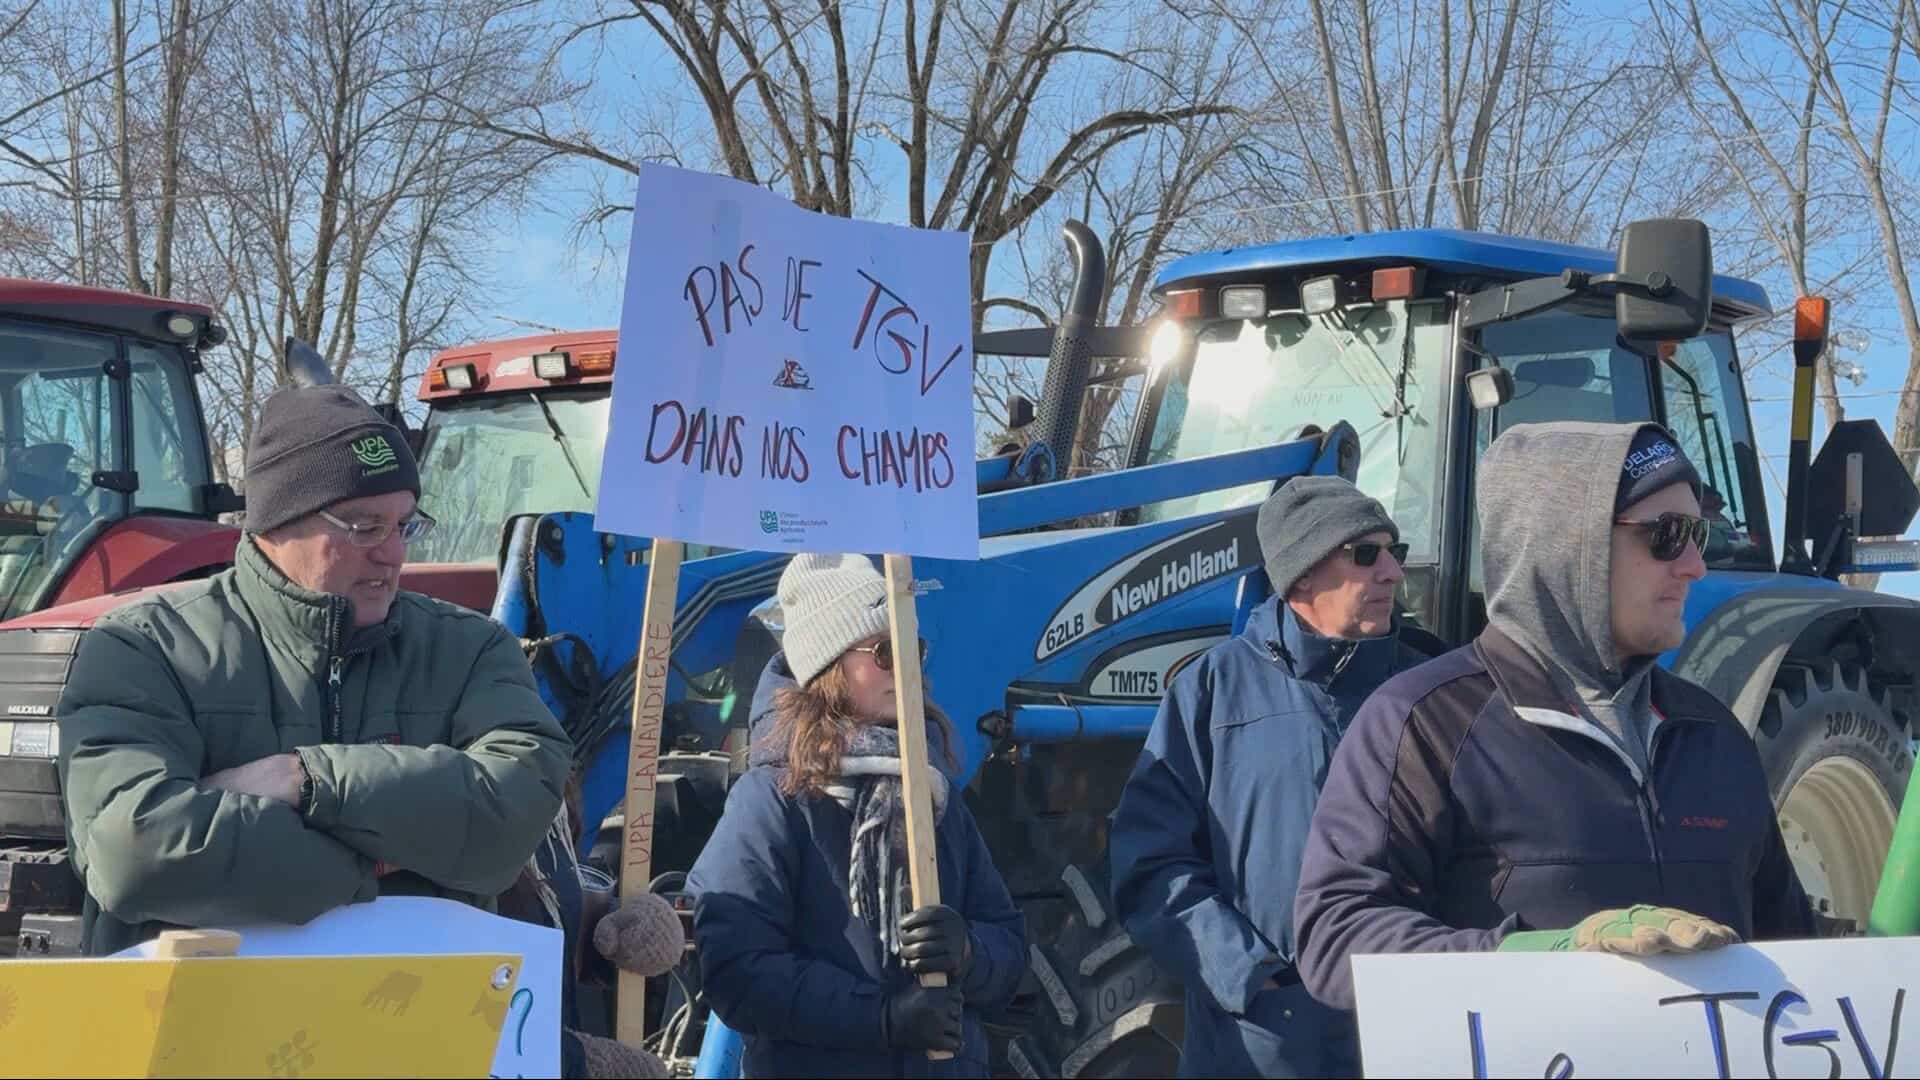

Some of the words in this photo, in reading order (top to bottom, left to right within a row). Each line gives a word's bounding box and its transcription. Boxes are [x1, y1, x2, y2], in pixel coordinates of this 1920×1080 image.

[684, 244, 764, 347] PAS
[782, 256, 823, 332] DE
[853, 268, 963, 396] TGV
[351, 435, 390, 454] UPA
[645, 400, 745, 478] DANS
[761, 422, 809, 483] NOS
[836, 425, 954, 493] CHAMPS
[760, 510, 777, 521] UPA
[1111, 577, 1160, 621] New
[1161, 537, 1239, 597] Holland
[1045, 613, 1084, 652] 62LB
[1108, 670, 1158, 694] TM175
[629, 811, 652, 866] UPA
[1657, 987, 1907, 1079] TGV
